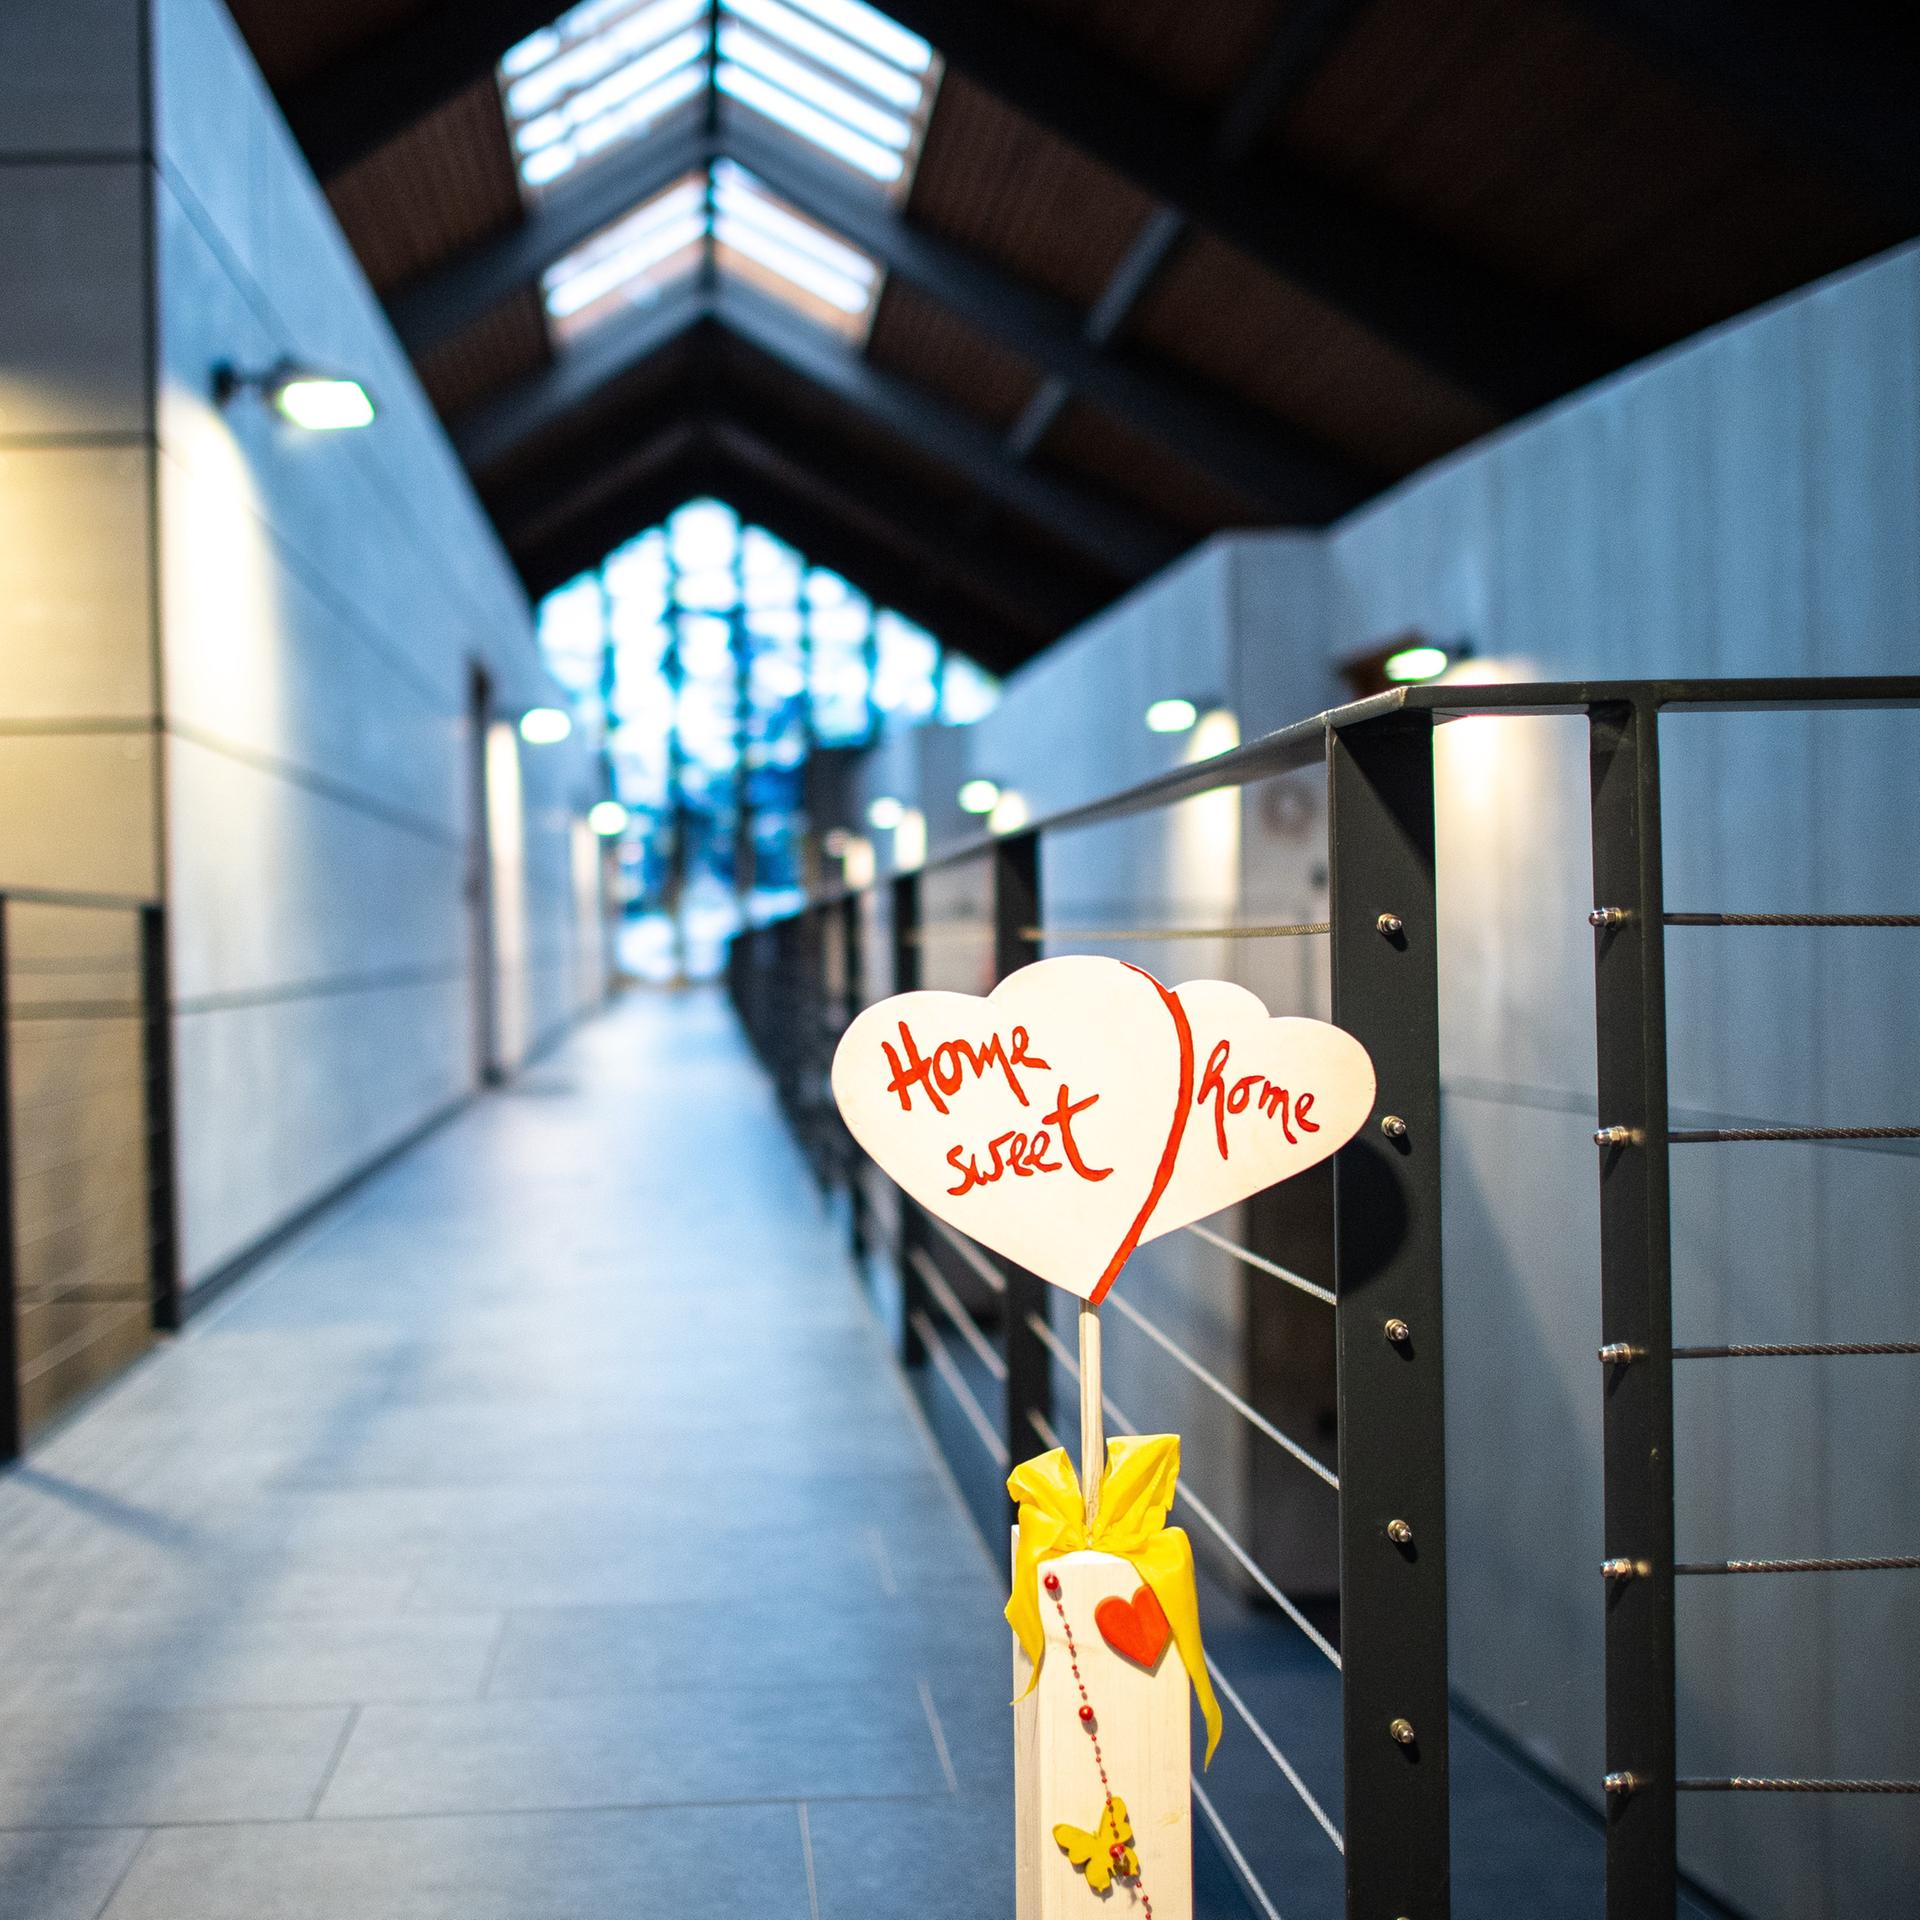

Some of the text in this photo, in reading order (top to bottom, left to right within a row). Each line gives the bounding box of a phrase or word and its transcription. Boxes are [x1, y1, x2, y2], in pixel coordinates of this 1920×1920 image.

[880, 1021, 1051, 1115] Home
[1197, 1040, 1321, 1160] home
[946, 1084, 1114, 1197] sweet
